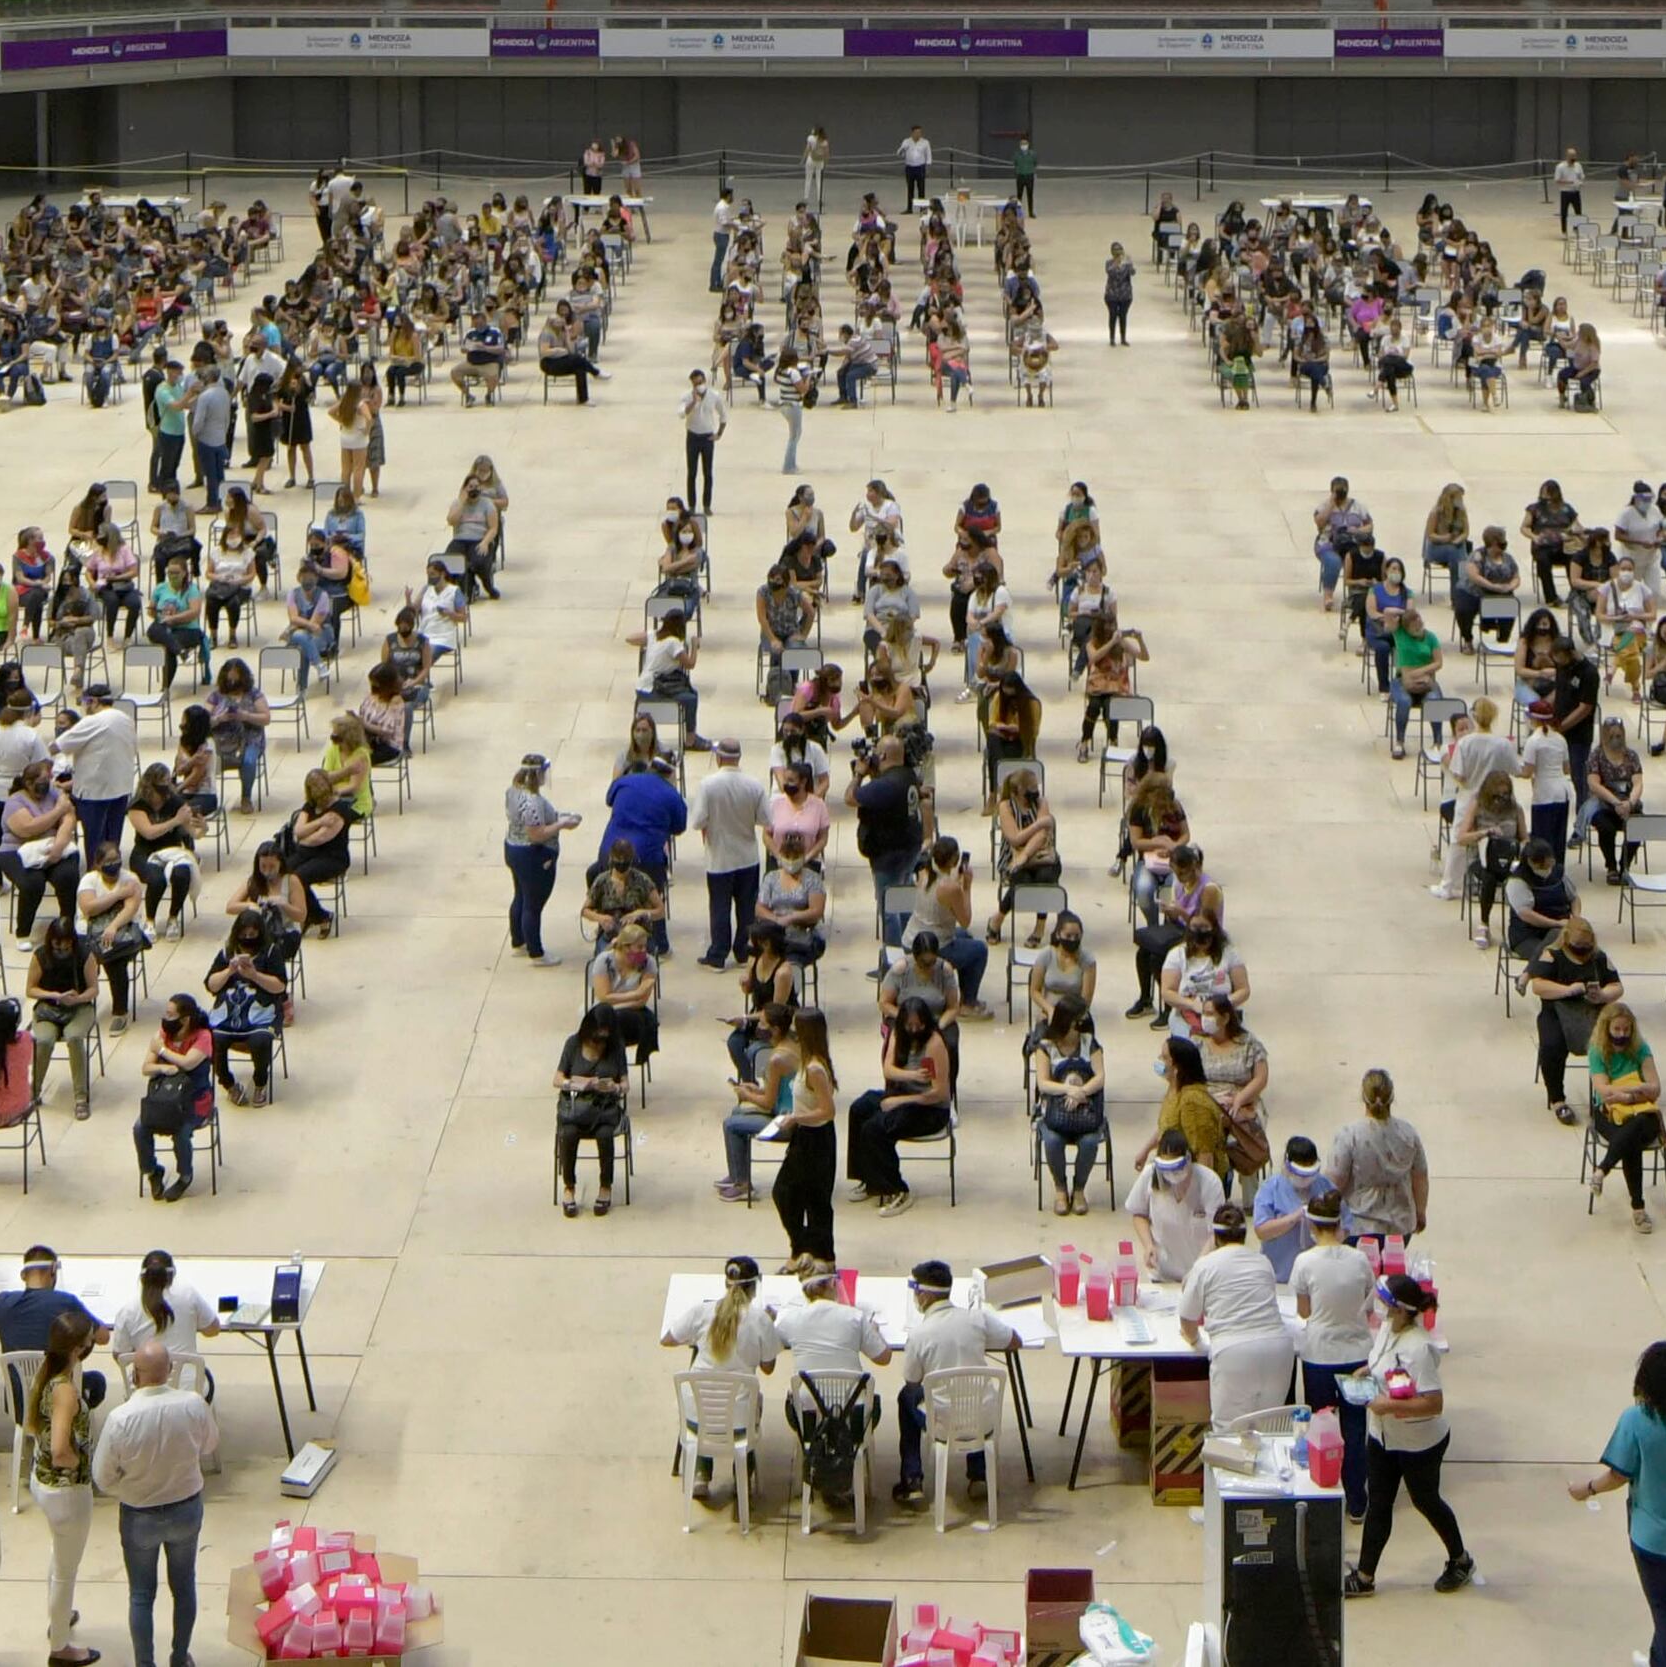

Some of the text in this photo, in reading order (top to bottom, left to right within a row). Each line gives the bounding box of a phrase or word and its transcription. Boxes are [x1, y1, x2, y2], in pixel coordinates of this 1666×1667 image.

[368, 34, 412, 42] MENDOZA
[1220, 34, 1264, 42] MENDOZA
[1585, 35, 1628, 43] MENDOZA
[492, 38, 596, 47] MENDOZA ARGENTINA
[914, 38, 1023, 47] MENDOZA ARGENTINA
[1336, 38, 1442, 47] MENDOZA ARGENTINA
